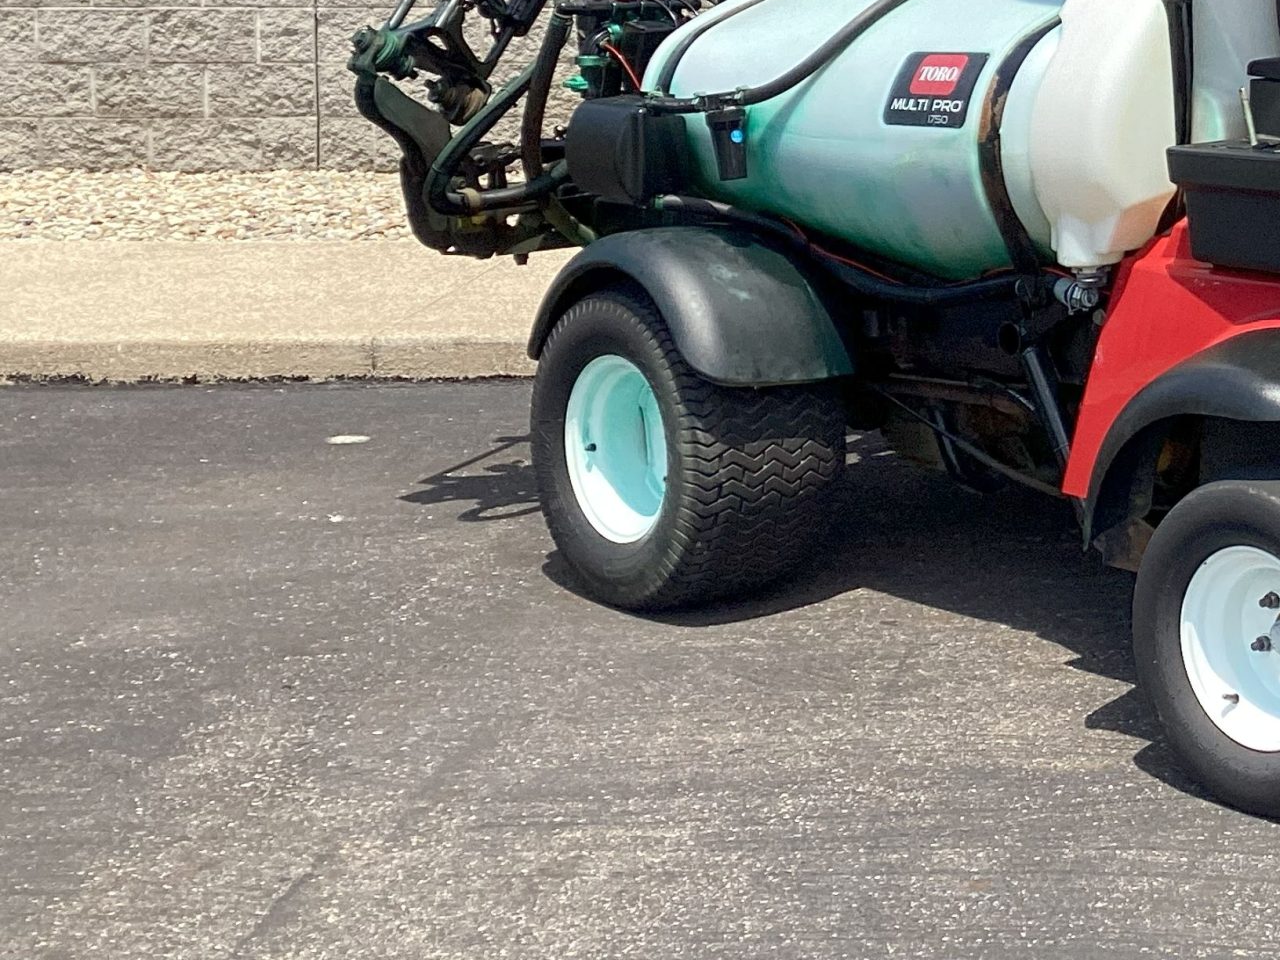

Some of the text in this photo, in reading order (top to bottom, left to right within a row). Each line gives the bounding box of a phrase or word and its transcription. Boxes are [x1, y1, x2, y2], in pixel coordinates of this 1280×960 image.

[919, 66, 959, 81] TORO
[891, 98, 962, 112] MULTI PRO
[927, 114, 949, 124] 1750
